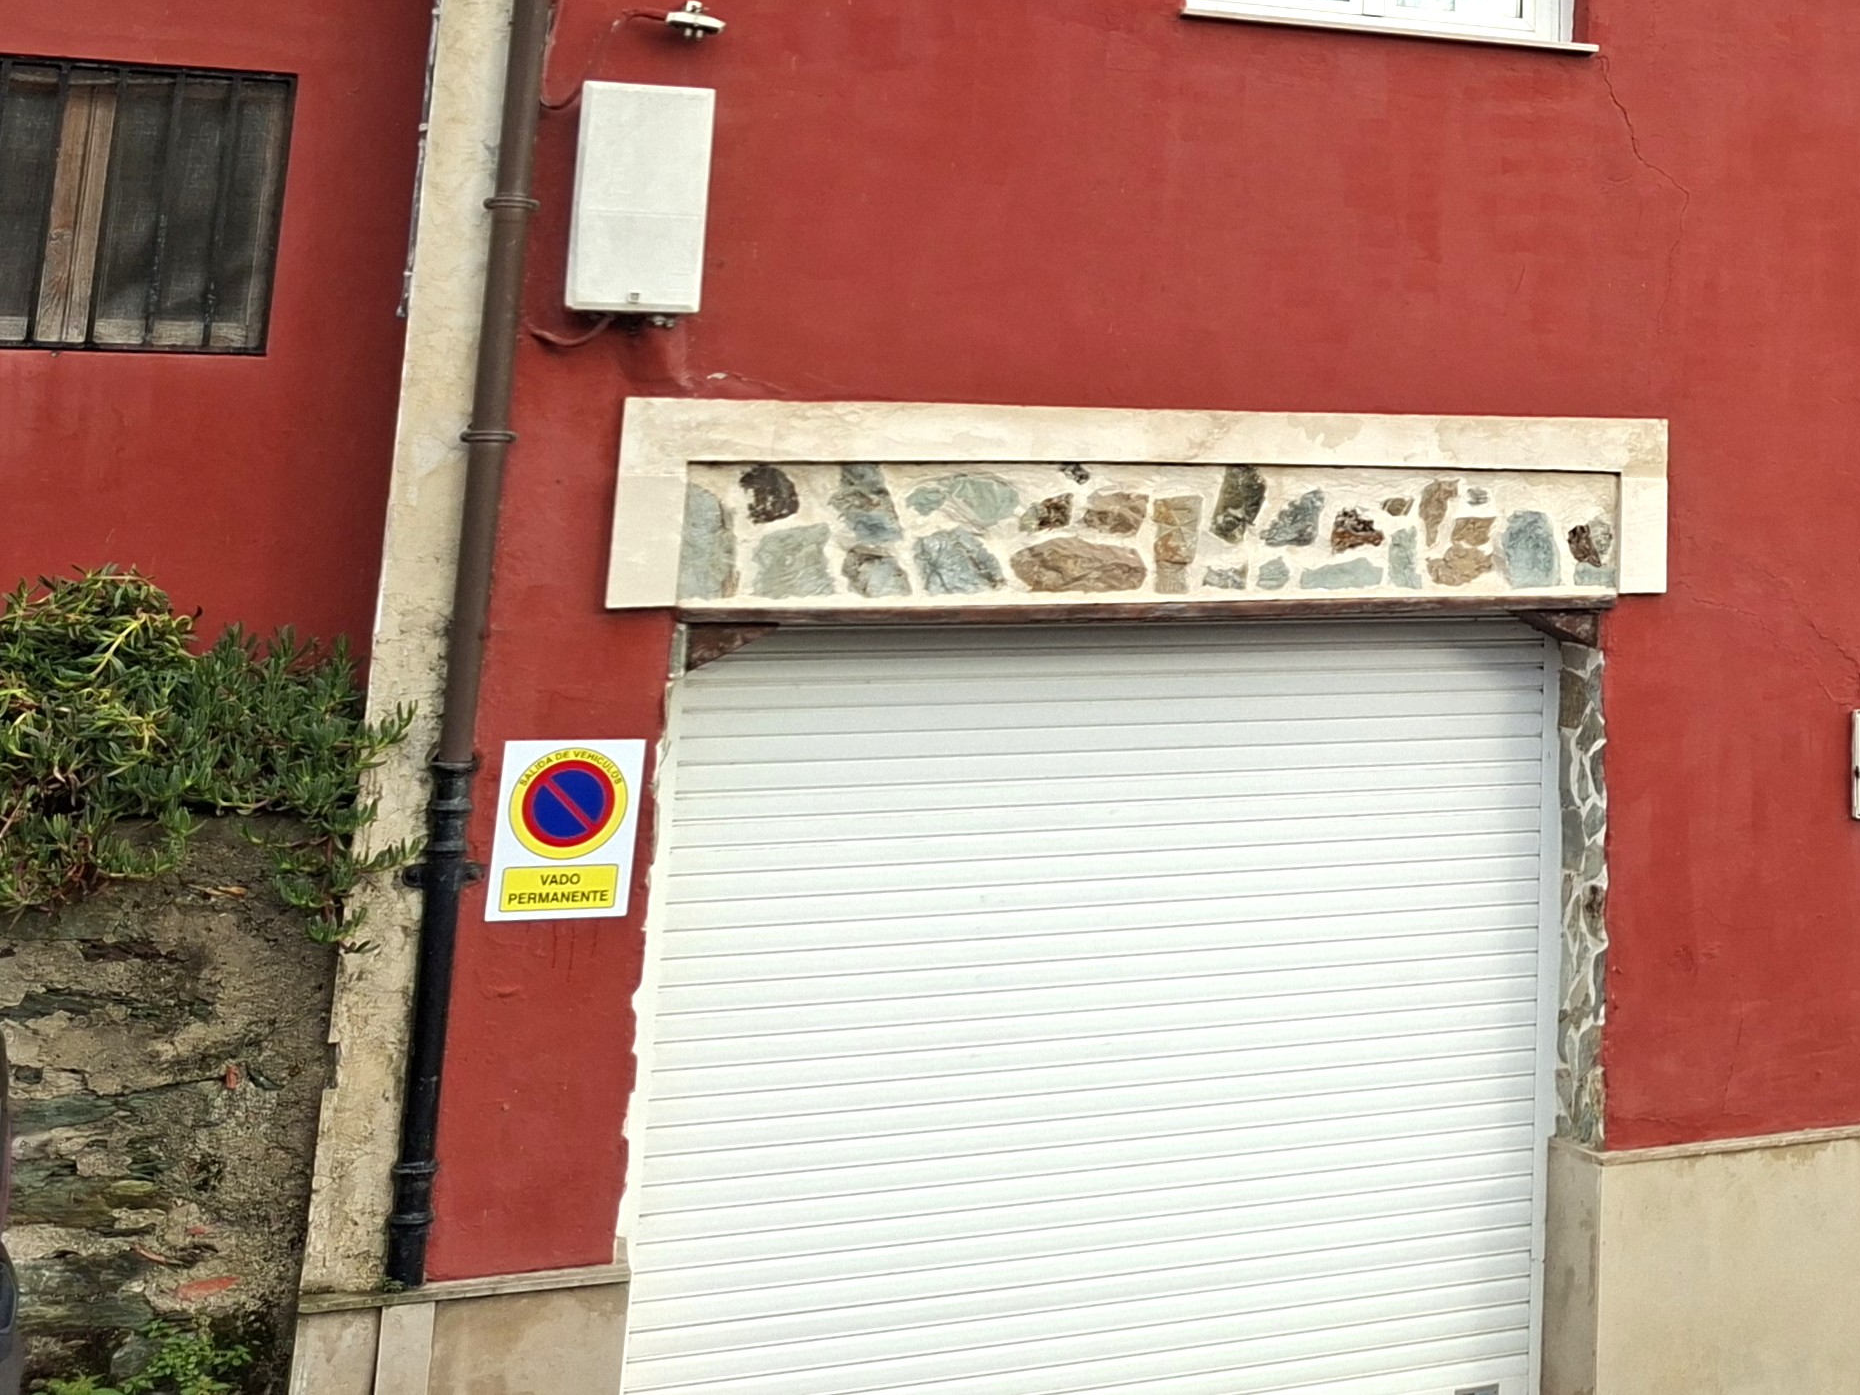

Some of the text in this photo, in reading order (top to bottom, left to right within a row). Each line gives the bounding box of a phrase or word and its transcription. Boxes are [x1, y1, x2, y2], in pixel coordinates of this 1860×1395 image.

[519, 750, 623, 787] SALIDA DE VEHICULOS
[540, 873, 581, 886] VADO
[507, 889, 610, 905] PERMANENTE
